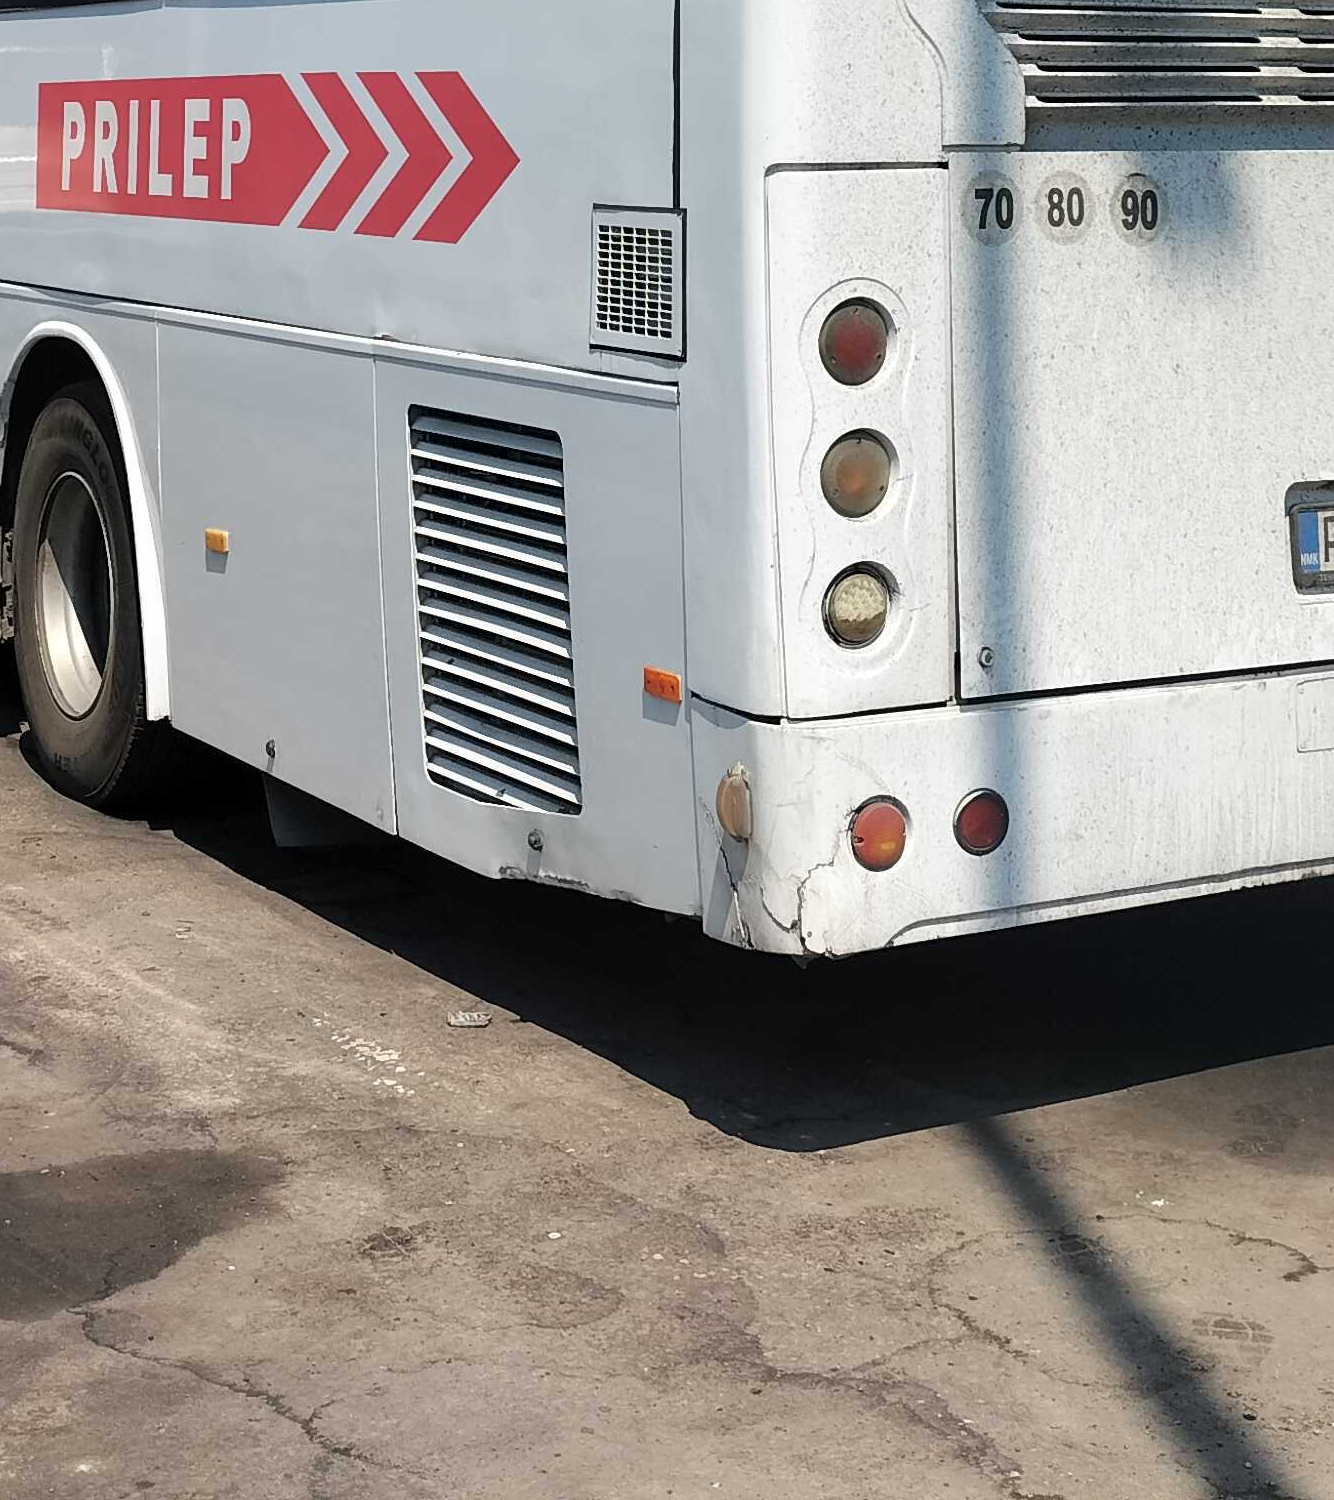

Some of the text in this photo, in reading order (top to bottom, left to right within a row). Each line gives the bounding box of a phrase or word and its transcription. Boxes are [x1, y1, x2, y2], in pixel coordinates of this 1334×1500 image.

[61, 98, 252, 200] PRILEP
[974, 187, 1014, 230] 70
[1047, 187, 1085, 228] 80
[1121, 189, 1159, 231] 90
